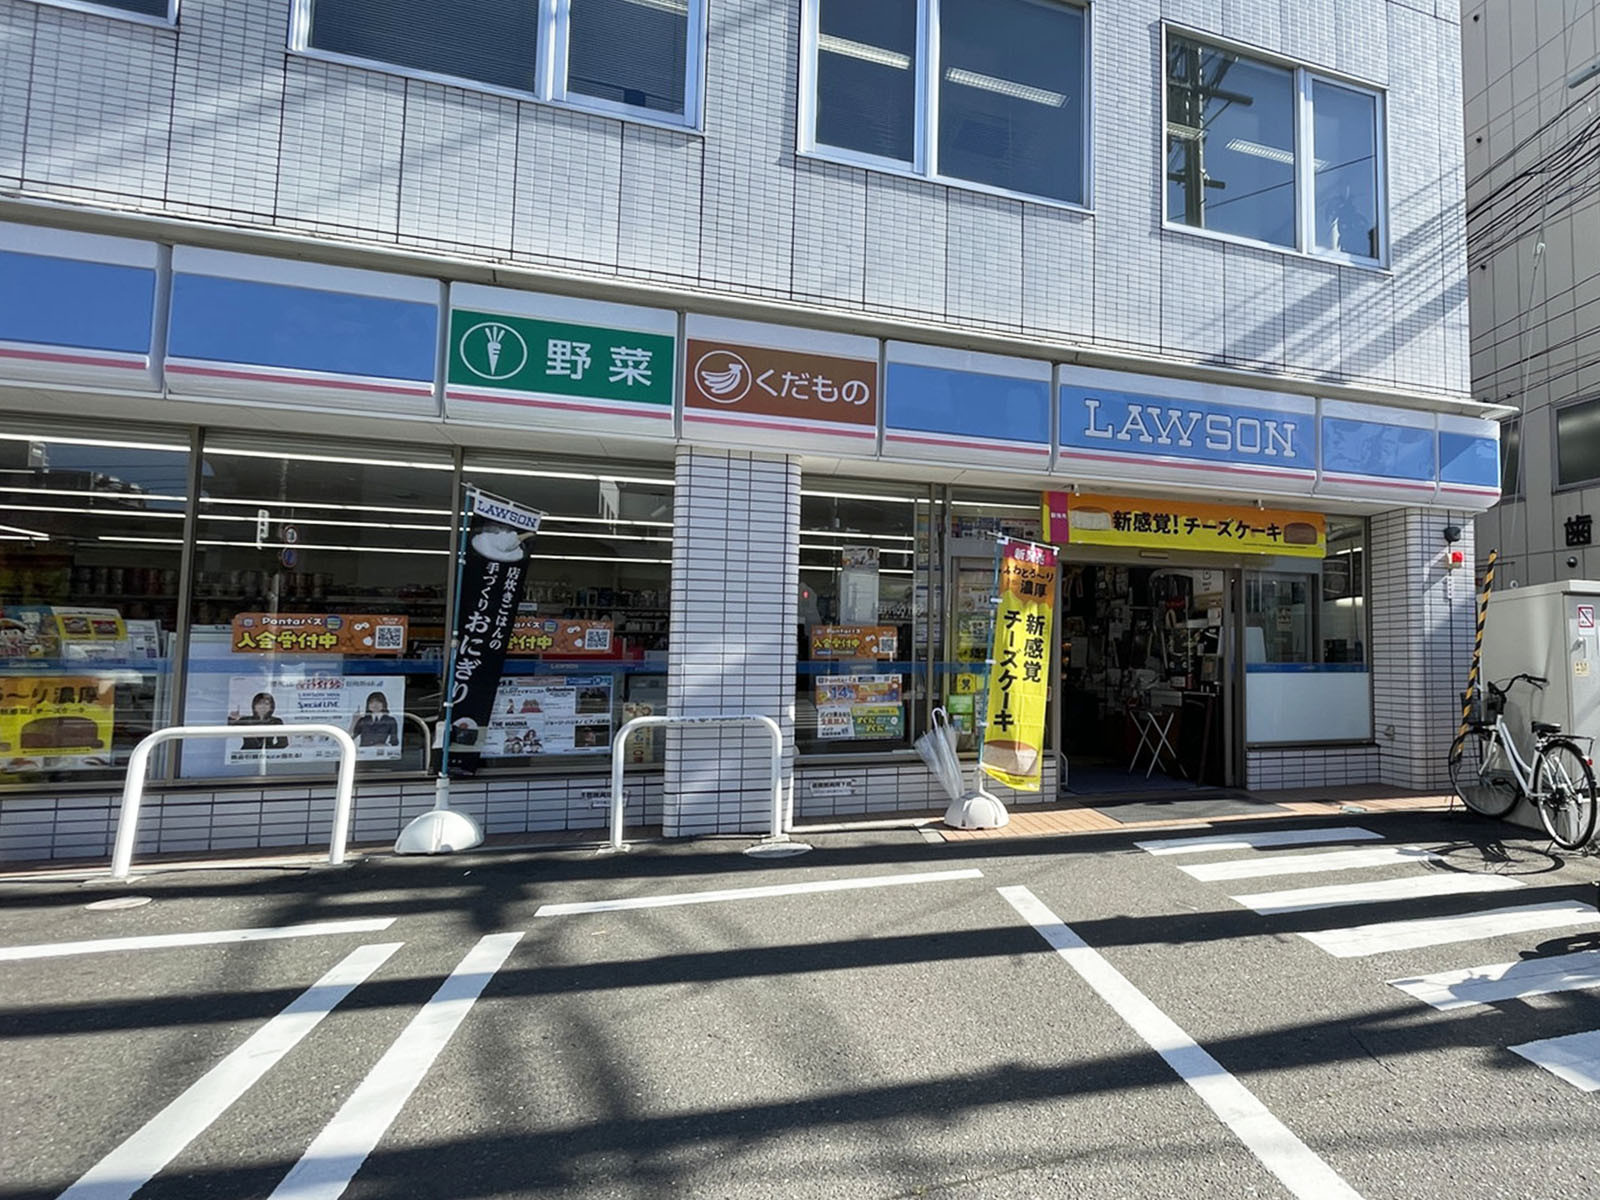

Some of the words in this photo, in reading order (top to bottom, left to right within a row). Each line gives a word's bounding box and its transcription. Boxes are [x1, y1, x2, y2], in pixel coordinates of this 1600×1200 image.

[545, 338, 653, 387] 野菜
[755, 368, 870, 406] くだもの
[1083, 398, 1297, 459] LAWSON
[476, 500, 538, 528] LAWSON
[1563, 514, 1593, 547] 歯
[488, 565, 521, 651] 店炊きごはんの
[237, 631, 338, 650] 入会受付中
[1022, 613, 1046, 684] 新感覚
[993, 609, 1022, 733] チーズケーキ
